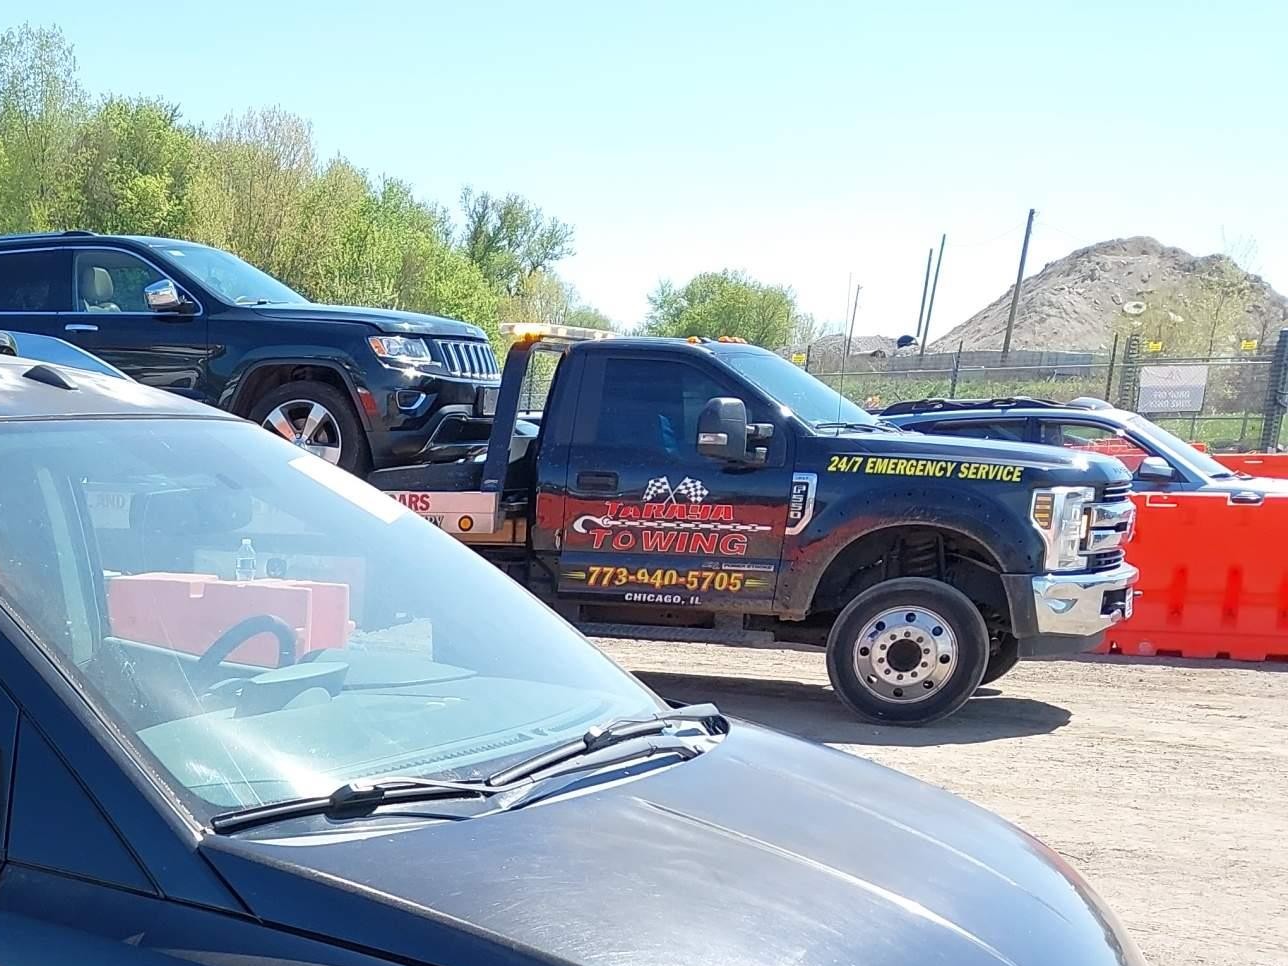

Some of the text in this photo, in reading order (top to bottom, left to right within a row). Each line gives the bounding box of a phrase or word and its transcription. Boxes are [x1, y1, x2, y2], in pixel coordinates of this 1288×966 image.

[827, 456, 1024, 482] 24/7 EMERGENCY SERVICE
[589, 529, 748, 555] TOWING
[586, 566, 744, 592] 773-940-5705
[624, 592, 702, 605] CHICAGO, IL
